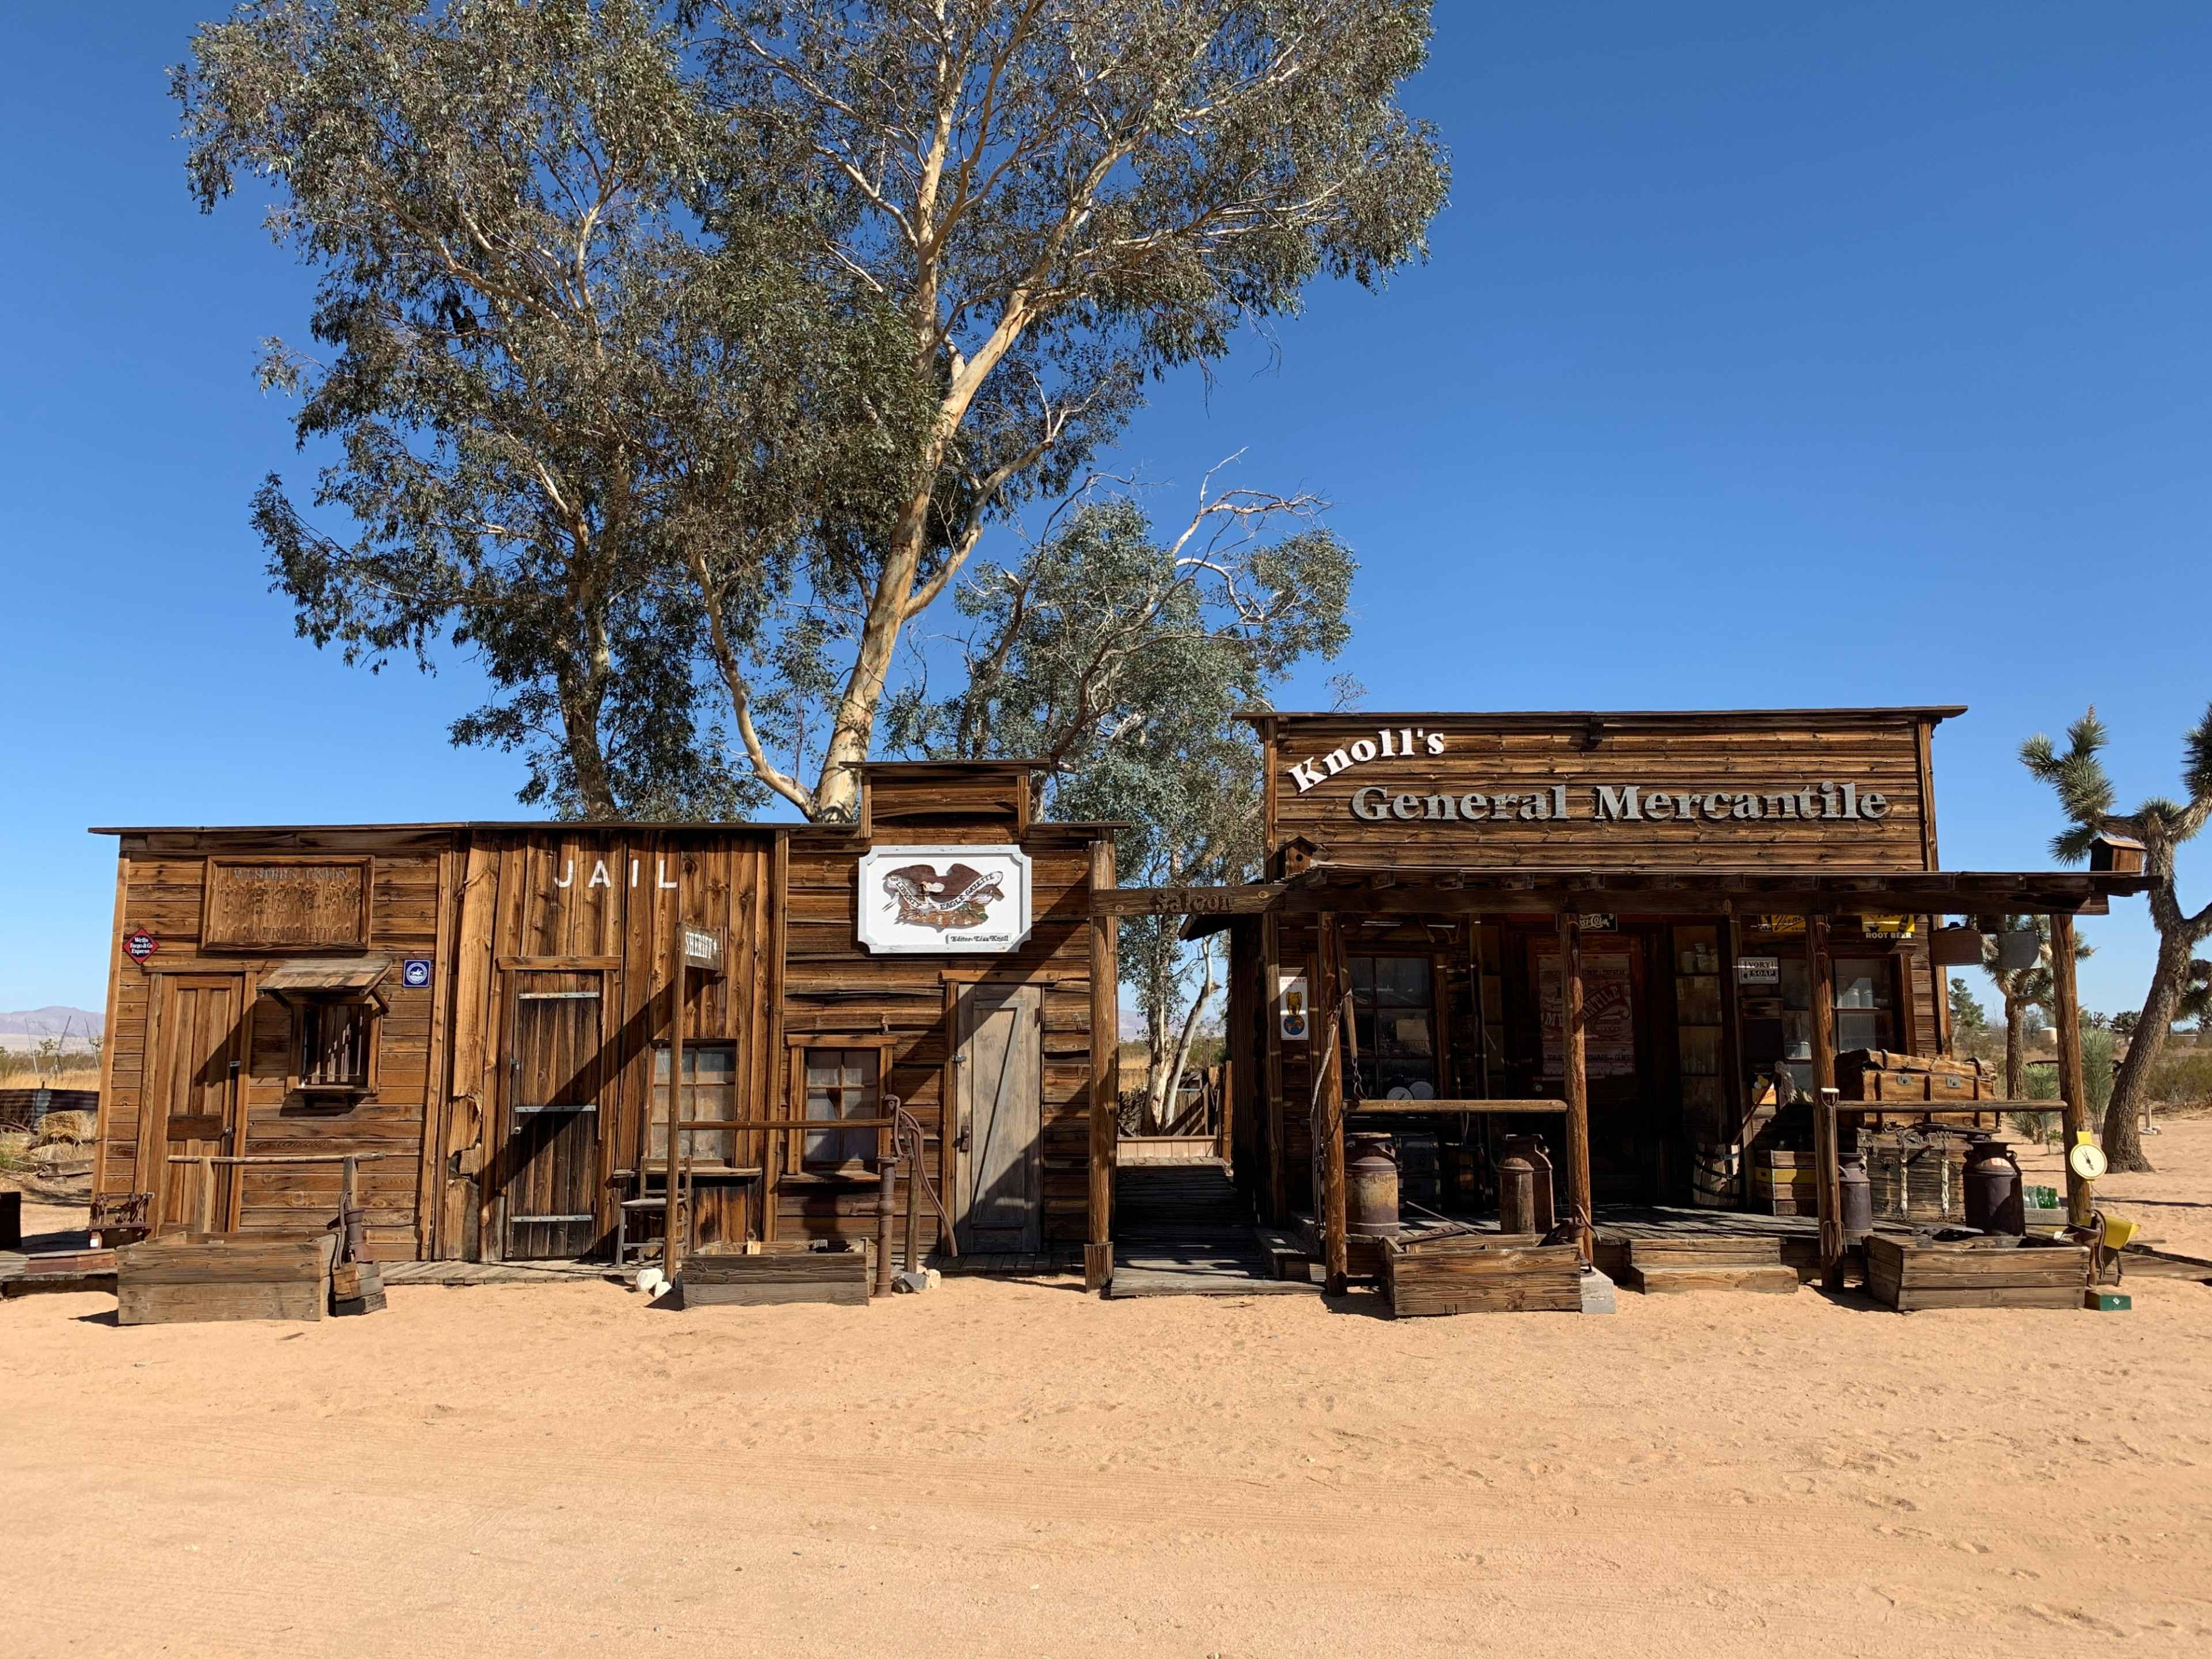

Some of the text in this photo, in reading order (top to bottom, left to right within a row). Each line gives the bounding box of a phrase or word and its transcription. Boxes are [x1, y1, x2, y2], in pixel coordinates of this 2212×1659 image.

[1287, 728, 1445, 793] Knoll's
[1352, 781, 1887, 820] General Mercantile
[554, 859, 678, 888] JAIL
[896, 881, 922, 908] LIBERTY
[940, 895, 965, 910] EAGLE
[965, 874, 995, 896] GAZETTE
[1155, 889, 1234, 914] Saloon
[685, 931, 713, 959] SHERIFF
